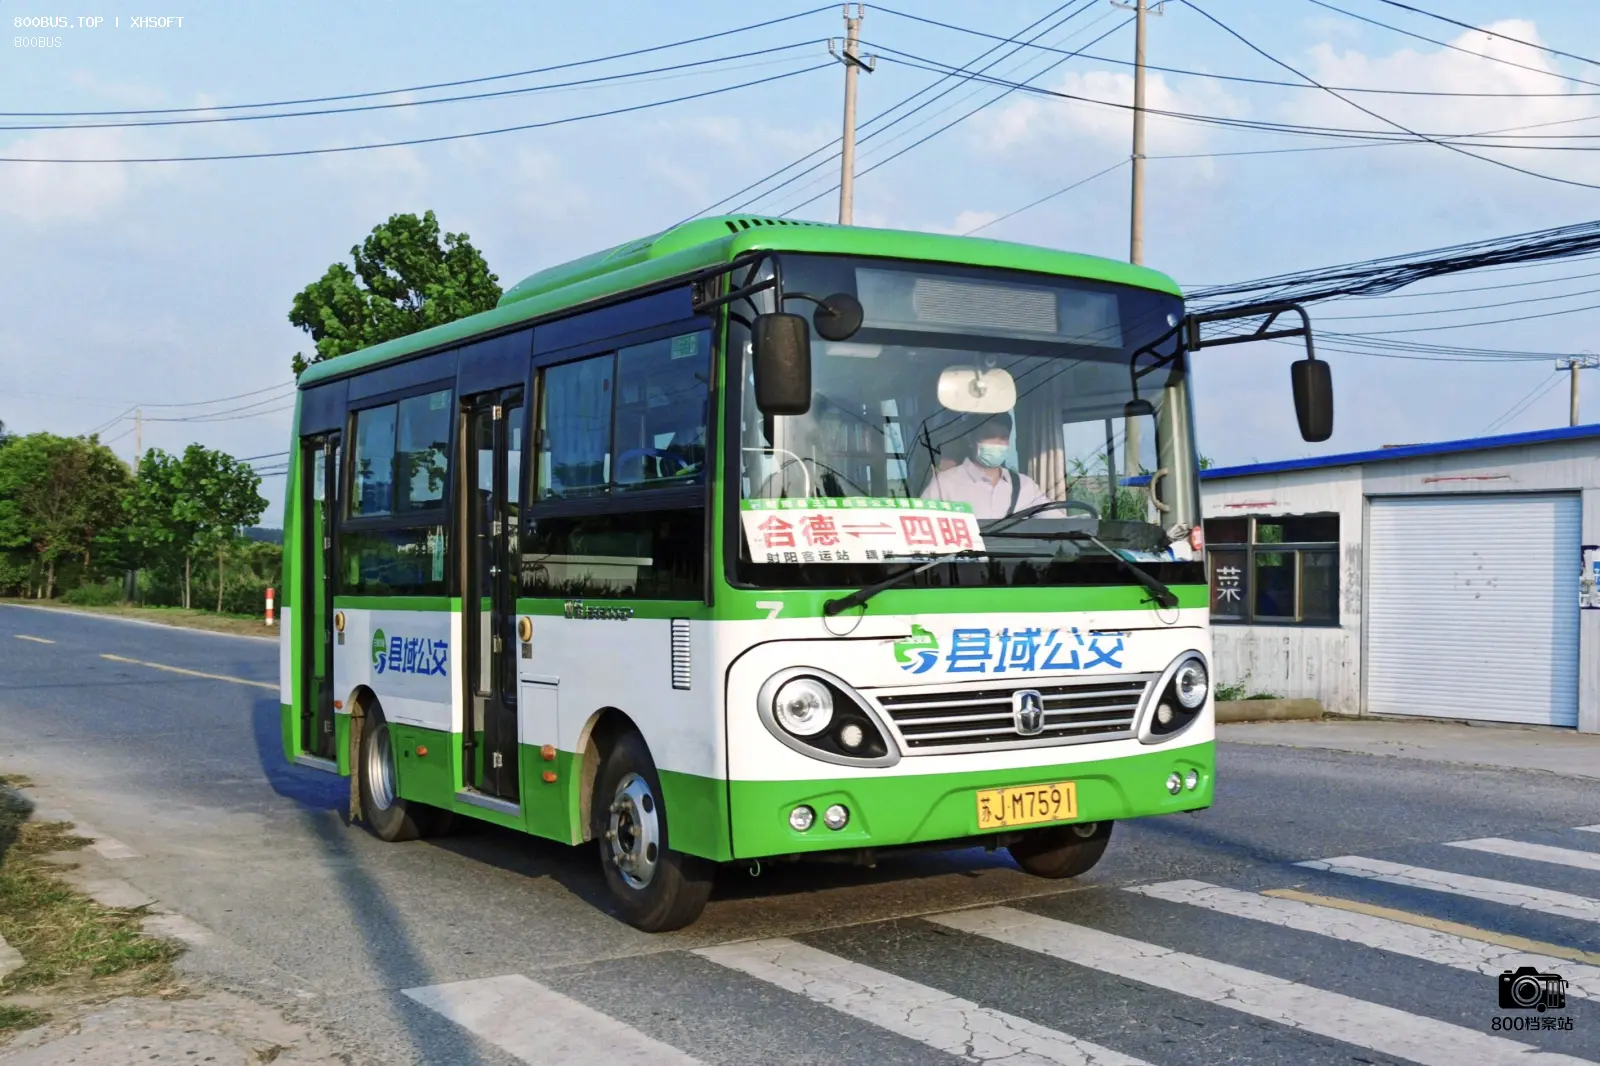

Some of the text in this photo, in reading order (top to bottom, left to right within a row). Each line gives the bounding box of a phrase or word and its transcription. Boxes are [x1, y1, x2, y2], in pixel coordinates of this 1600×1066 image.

[757, 514, 974, 548] 合德 四明
[1216, 566, 1242, 603] 菜
[388, 636, 448, 677] 县域公交
[946, 627, 1124, 673] 县域公交
